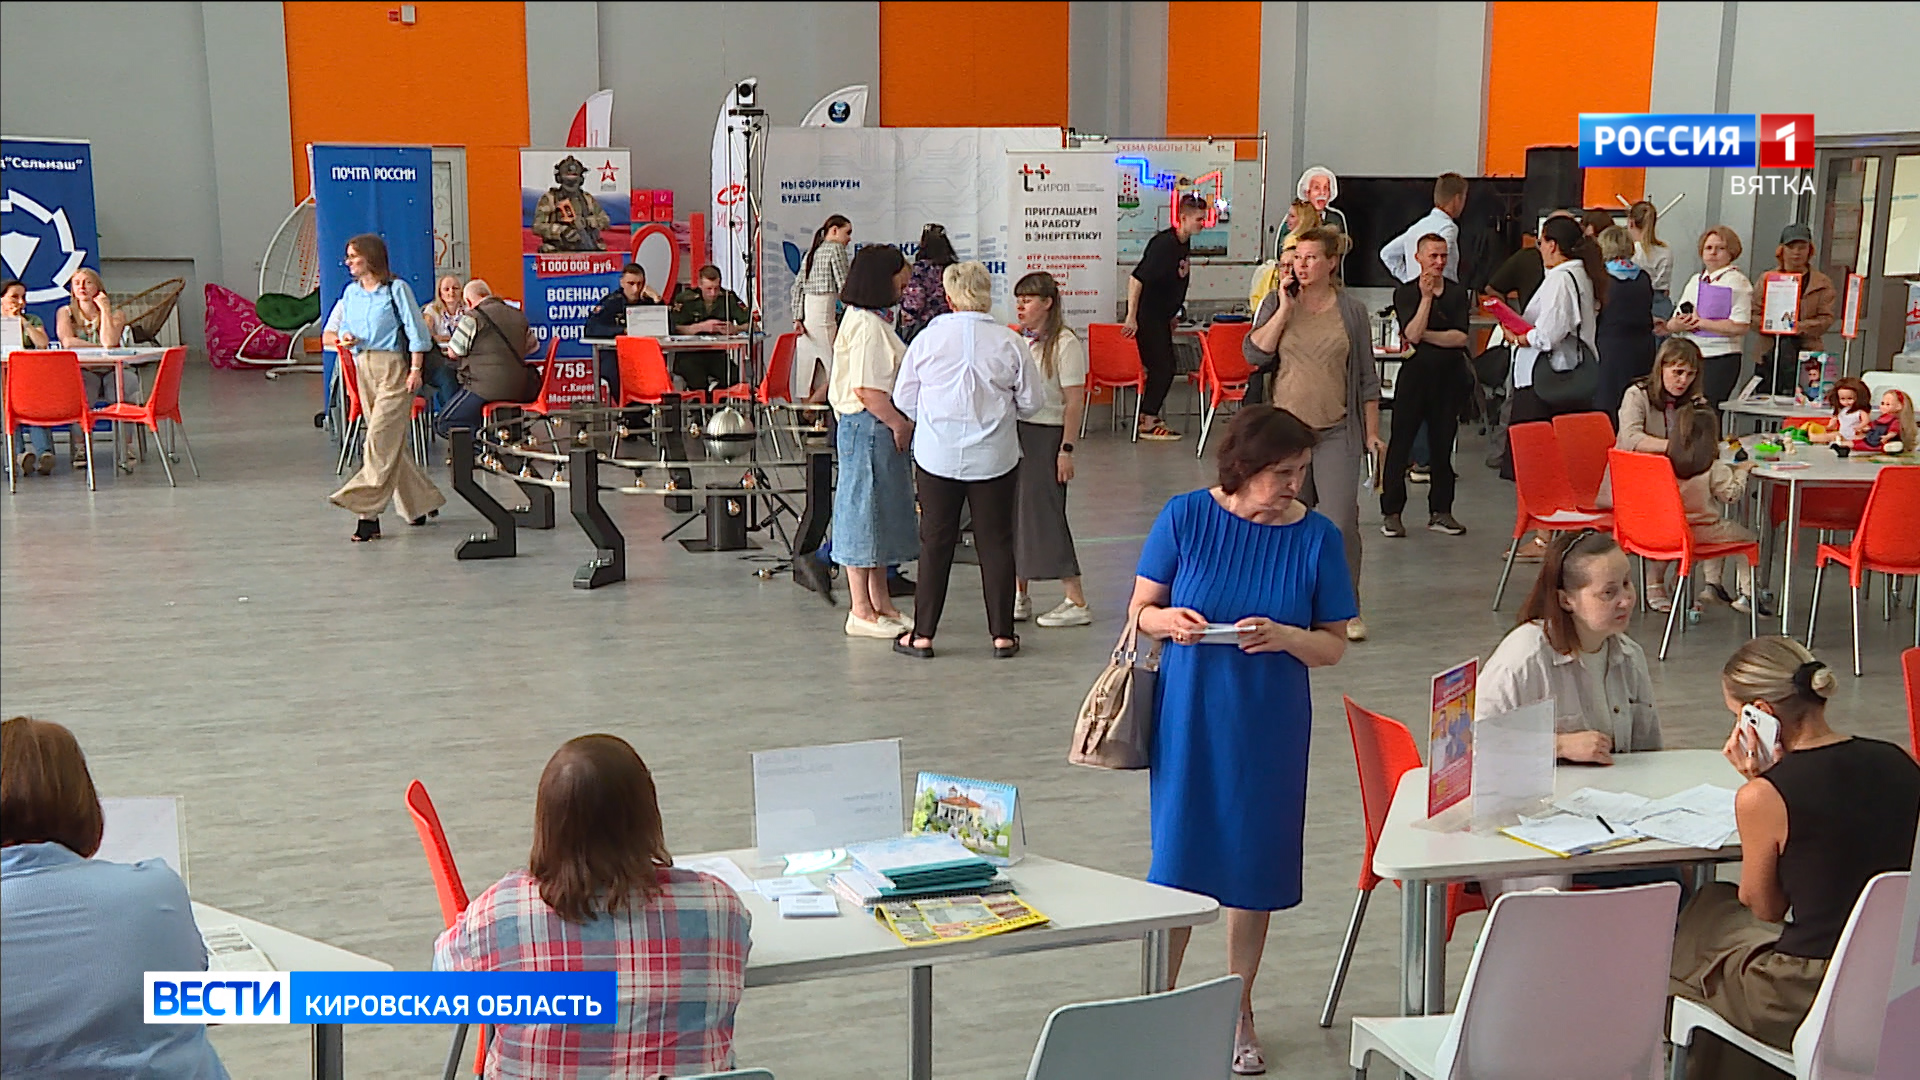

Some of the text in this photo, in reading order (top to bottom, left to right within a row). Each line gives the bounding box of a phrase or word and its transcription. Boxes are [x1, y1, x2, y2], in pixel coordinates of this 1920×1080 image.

[331, 166, 416, 180] ПОЧТА РОССИИ
[798, 179, 861, 190] ФОРМИРУЕМ
[1024, 207, 1098, 216] ПРИГЛАШАЕМ
[1024, 219, 1081, 228] НА РАБОТУ
[1024, 231, 1102, 241] В ЭНЕРГЕТИКУ!
[593, 259, 616, 274] руб.
[547, 287, 609, 302] ВОЕННАЯ
